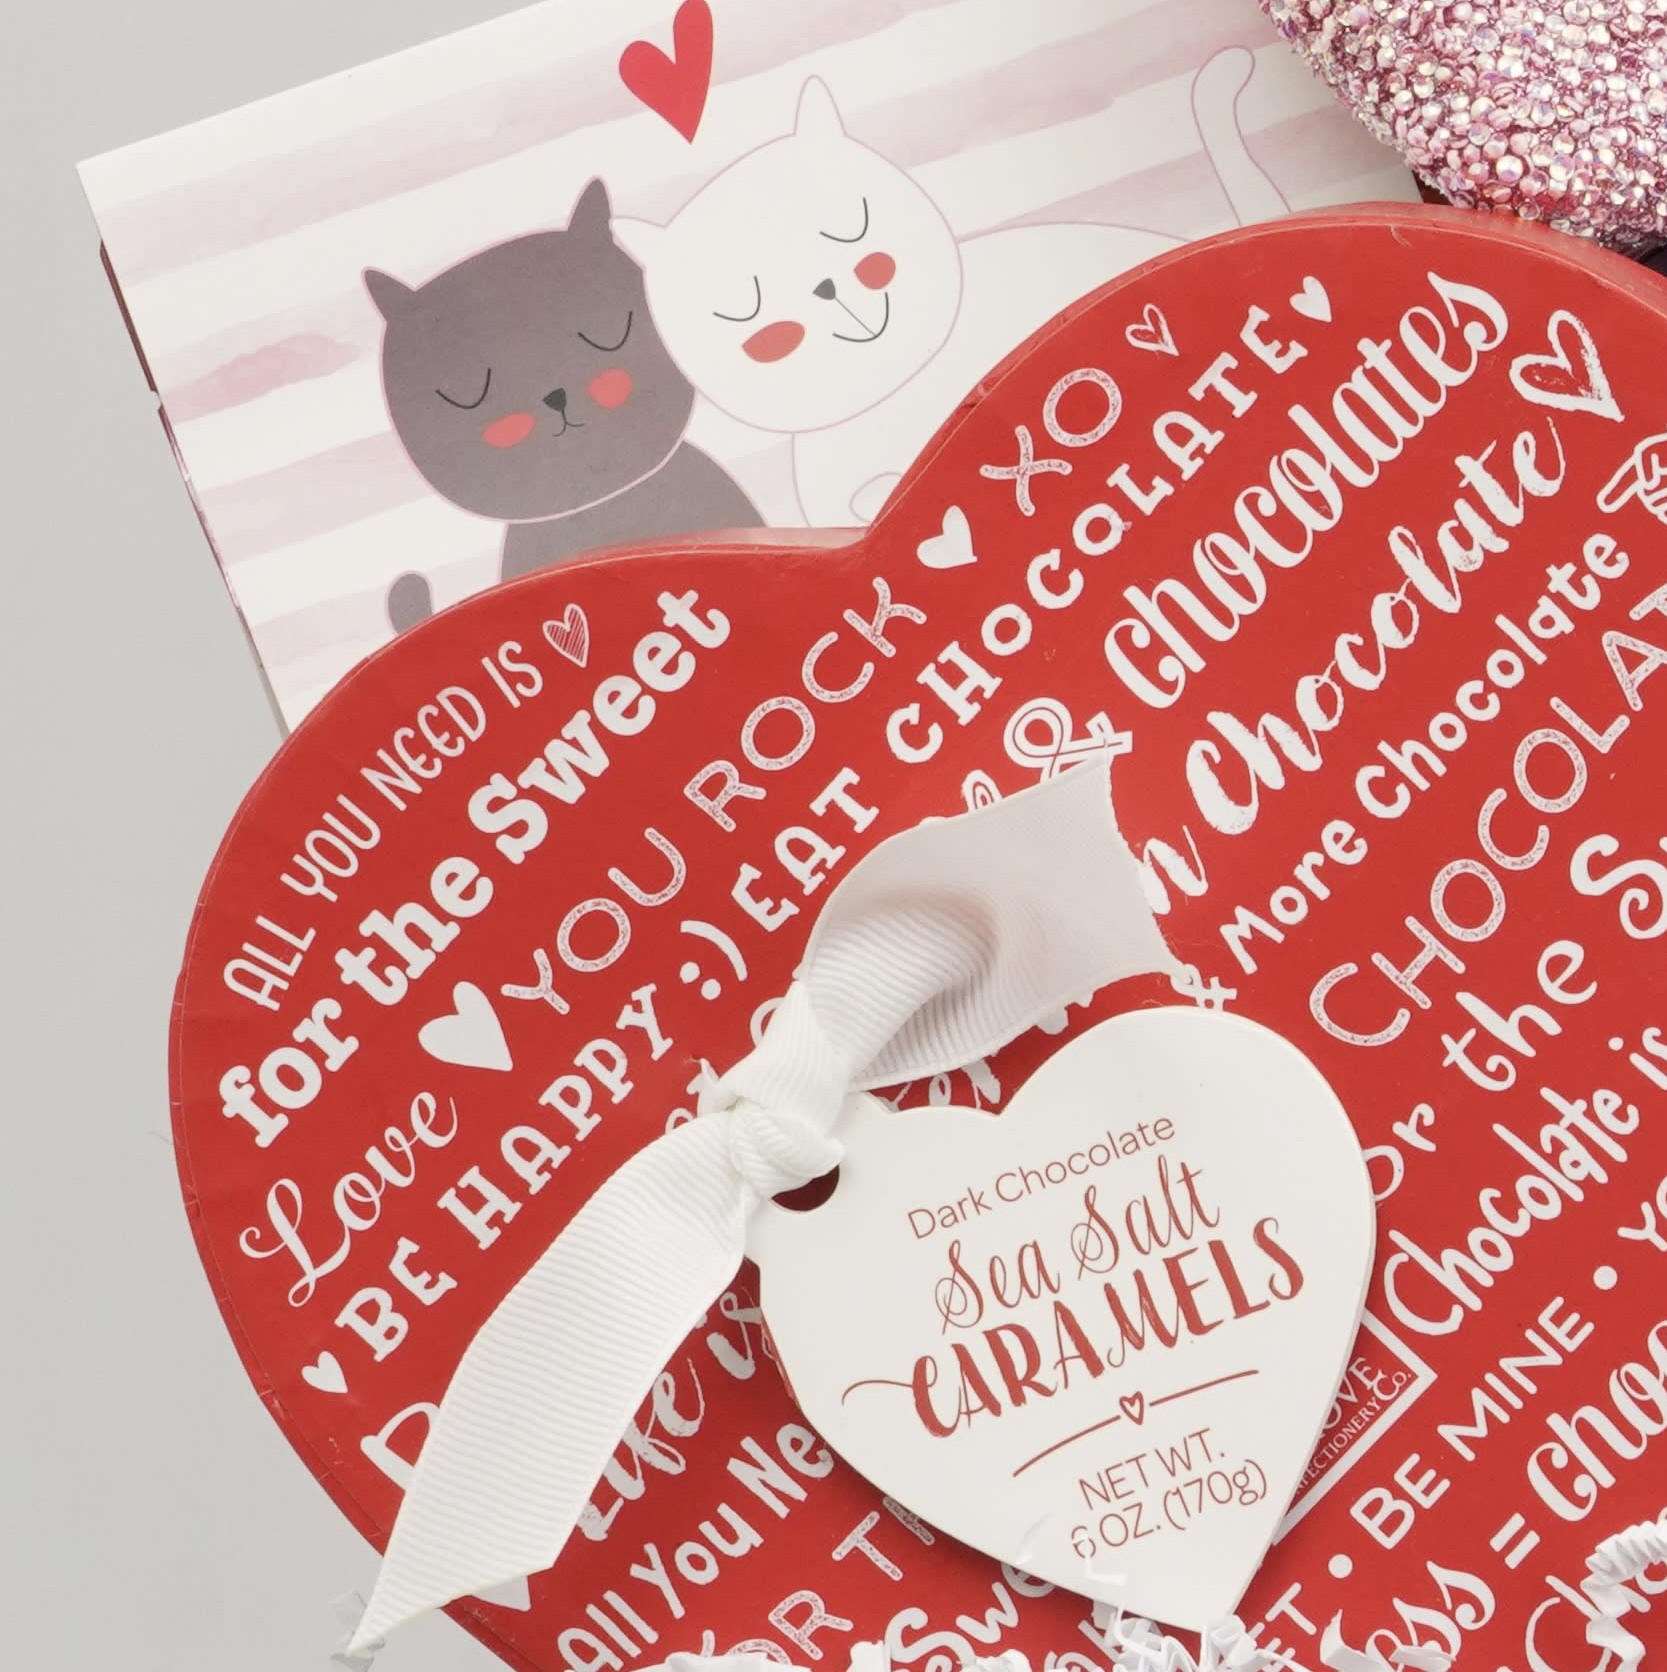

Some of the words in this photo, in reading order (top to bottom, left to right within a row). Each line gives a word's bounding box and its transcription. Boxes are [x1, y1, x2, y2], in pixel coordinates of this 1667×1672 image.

[219, 997, 360, 1147] for
[337, 855, 494, 1007] the
[468, 590, 732, 864] Sweet
[224, 915, 316, 1011] ALL
[281, 794, 381, 903] YOU
[364, 685, 488, 812] NEED
[482, 640, 545, 709] IS
[335, 1237, 458, 1363] BE
[437, 983, 675, 1250] HAPPY
[732, 768, 879, 932] EAT
[885, 304, 1309, 764] CHOCOLATE
[500, 827, 687, 1014] YOU
[685, 576, 926, 832] ROCK
[1220, 819, 1368, 974] More
[1441, 939, 1599, 1092] the
[239, 1088, 459, 1308] Love
[907, 1176, 992, 1240] Dark
[995, 1116, 1176, 1205] Chocolate
[934, 1238, 1062, 1336] Sea
[1069, 1154, 1222, 1283] Salt
[1385, 1085, 1641, 1336] Chocolate
[900, 1215, 1305, 1439] CARAMELS
[1349, 1453, 1451, 1551] BE
[1437, 1295, 1597, 1462] MINE
[1079, 1452, 1150, 1508] NET
[1154, 1427, 1226, 1487] WT.
[1099, 1501, 1164, 1551] OZ.
[1164, 1458, 1269, 1532] (170g)
